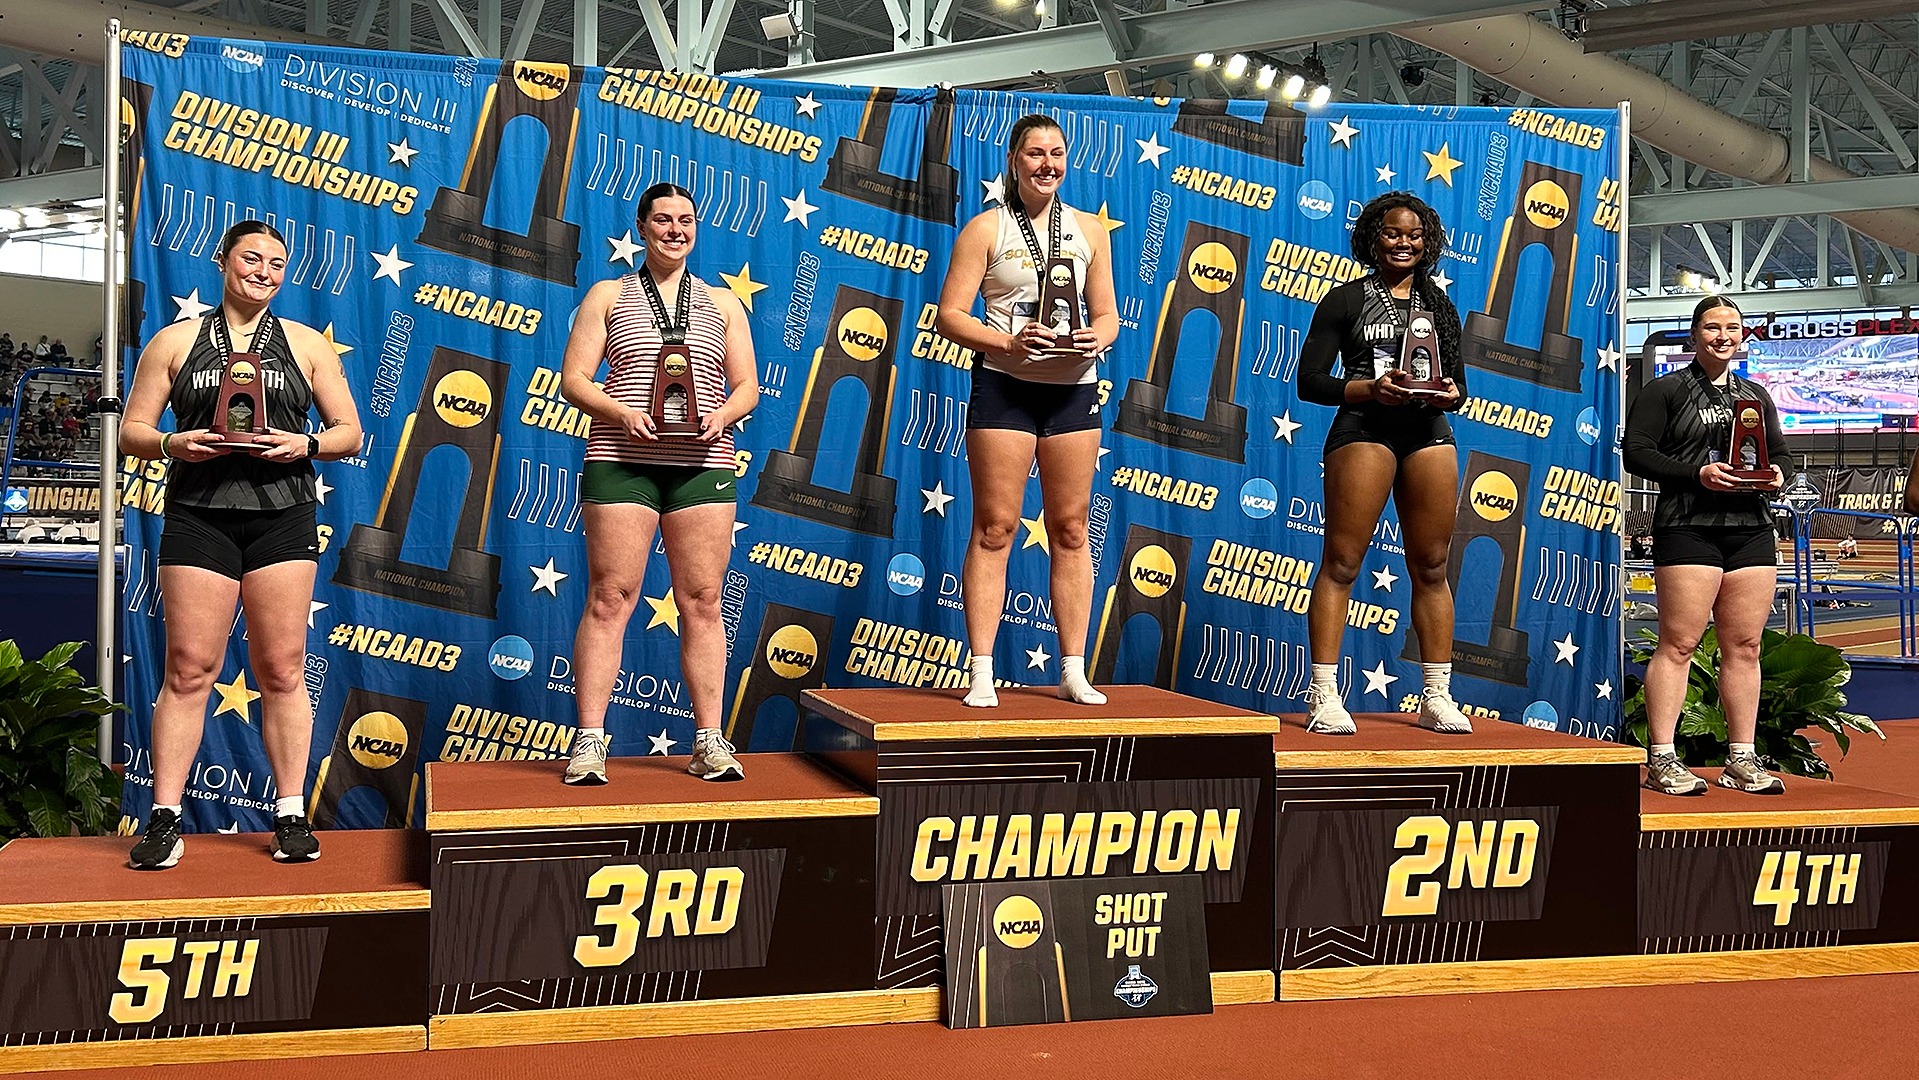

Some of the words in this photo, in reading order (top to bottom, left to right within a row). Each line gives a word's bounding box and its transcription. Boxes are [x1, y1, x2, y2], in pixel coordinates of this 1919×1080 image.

[222, 46, 264, 67] NCAA
[283, 54, 423, 114] DIVISION
[517, 66, 565, 93] NCAA
[280, 79, 334, 102] DISCOVER
[344, 97, 391, 116] DEVELOP
[400, 113, 451, 134] DEDICATE
[598, 75, 823, 163] CHAMPIONSHIPS
[171, 90, 310, 152] DIVISION
[312, 130, 349, 164] III
[1507, 107, 1607, 150] #NCAAD3
[164, 121, 419, 214] CHAMPIONSHIPS
[1478, 131, 1509, 221] #NCAAD3
[1171, 165, 1277, 210] #NCAAD3
[1300, 196, 1333, 213] NCAA
[1527, 199, 1566, 221] NCAA
[458, 231, 500, 253] NATIONAL
[500, 242, 547, 264] CHAMPION
[820, 225, 929, 272] #NCAAD3
[1139, 190, 1172, 286] #NCAAD3
[1192, 262, 1233, 285] NCAA
[413, 283, 542, 336] #NCAAD3
[783, 251, 821, 352] #NCAAD3
[841, 328, 884, 351] NCAA
[1768, 317, 1919, 340] CROSSPLEX
[371, 310, 415, 418] #NCAAD3
[1485, 350, 1519, 366] NATIONAL
[1519, 358, 1555, 375] CHAMPION
[437, 392, 487, 420] NCAA
[1146, 418, 1181, 436] NATIONAL
[1181, 427, 1225, 445] CHAMPION
[1110, 466, 1219, 511] #NCAAD3
[1242, 494, 1277, 511] NCAA
[1473, 491, 1515, 514] NCAA
[1544, 466, 1621, 507] DIVISIO
[1839, 494, 1881, 510] TRACK
[1881, 494, 1893, 510] &
[789, 492, 826, 510] NATIONAL
[826, 500, 868, 519] CHAMPION
[1287, 520, 1325, 535] DISCOVE
[748, 541, 864, 588] #NCAAD3
[888, 570, 923, 589] NCAA
[1133, 566, 1174, 589] NCAA
[1207, 539, 1315, 587] DIVISION
[374, 569, 417, 589] NATIONAL
[417, 577, 468, 598] CHAMPION
[328, 623, 463, 672] #NCAAD3
[769, 647, 813, 670] NCAA
[850, 618, 963, 667] DIVISION
[491, 653, 531, 675] NCAA
[445, 703, 576, 755] DIVISION
[350, 734, 404, 760] NCAA
[229, 796, 277, 812] DEDICAT
[910, 808, 1241, 882] CHAMPION
[1381, 815, 1540, 917] 2ND
[1753, 851, 1862, 926] 4TH
[573, 864, 745, 968] 3RD
[1095, 892, 1168, 925] SHOT
[999, 919, 1041, 935] NCAA
[1106, 926, 1162, 958] PUT
[109, 937, 260, 1024] 5TH
